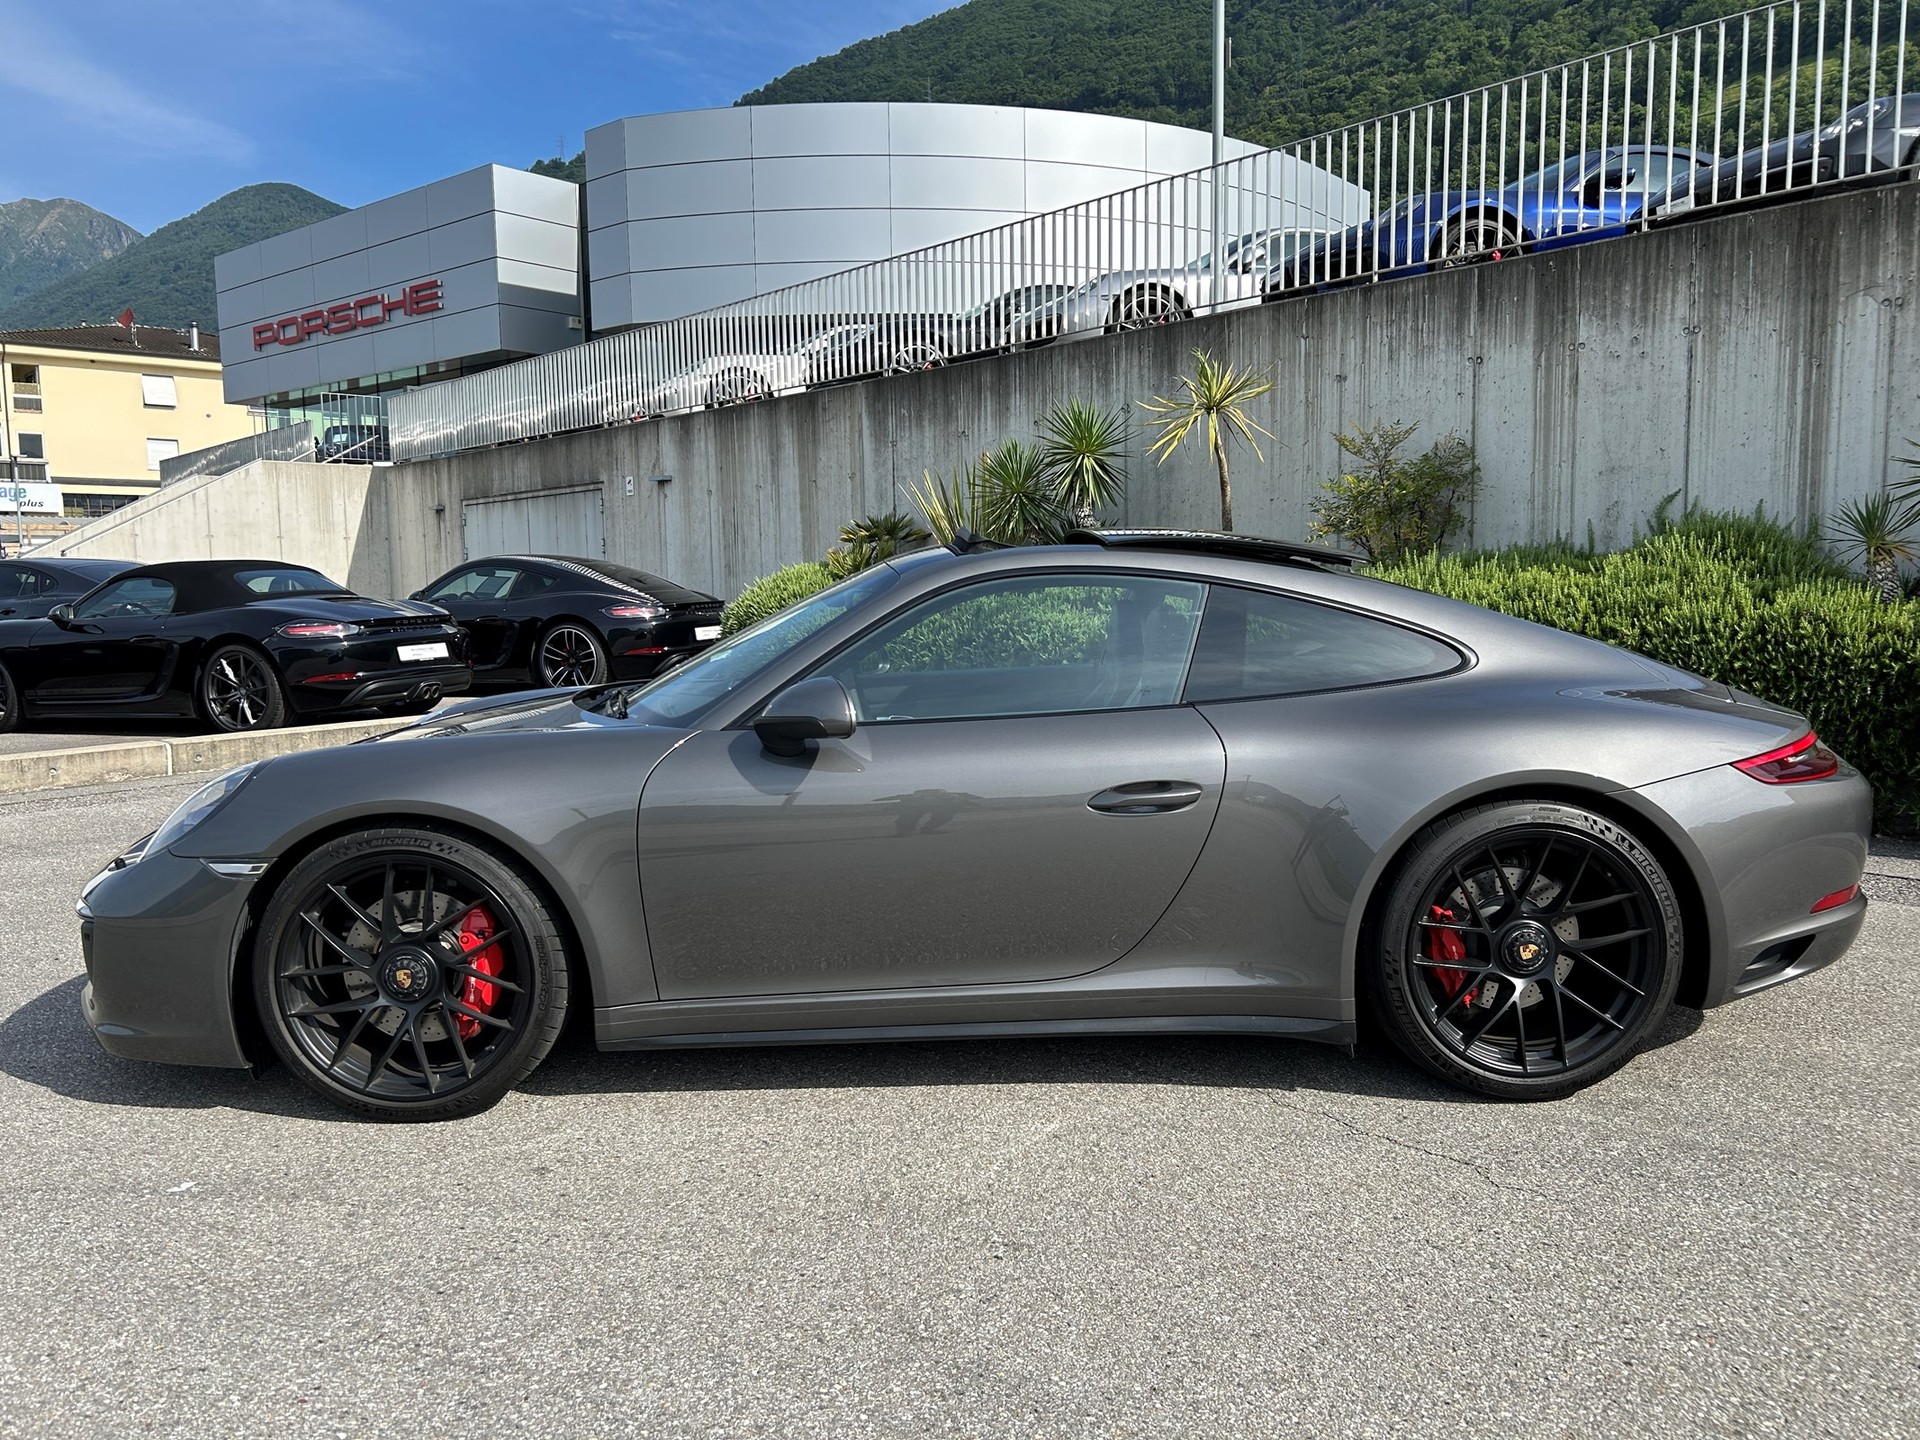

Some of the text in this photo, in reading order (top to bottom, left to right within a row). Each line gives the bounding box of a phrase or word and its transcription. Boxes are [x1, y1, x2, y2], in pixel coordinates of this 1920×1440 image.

[253, 279, 443, 351] PORSCHE
[19, 499, 44, 508] plus
[370, 836, 432, 849] MICHELIN
[1630, 848, 1675, 917] MICHELIN
